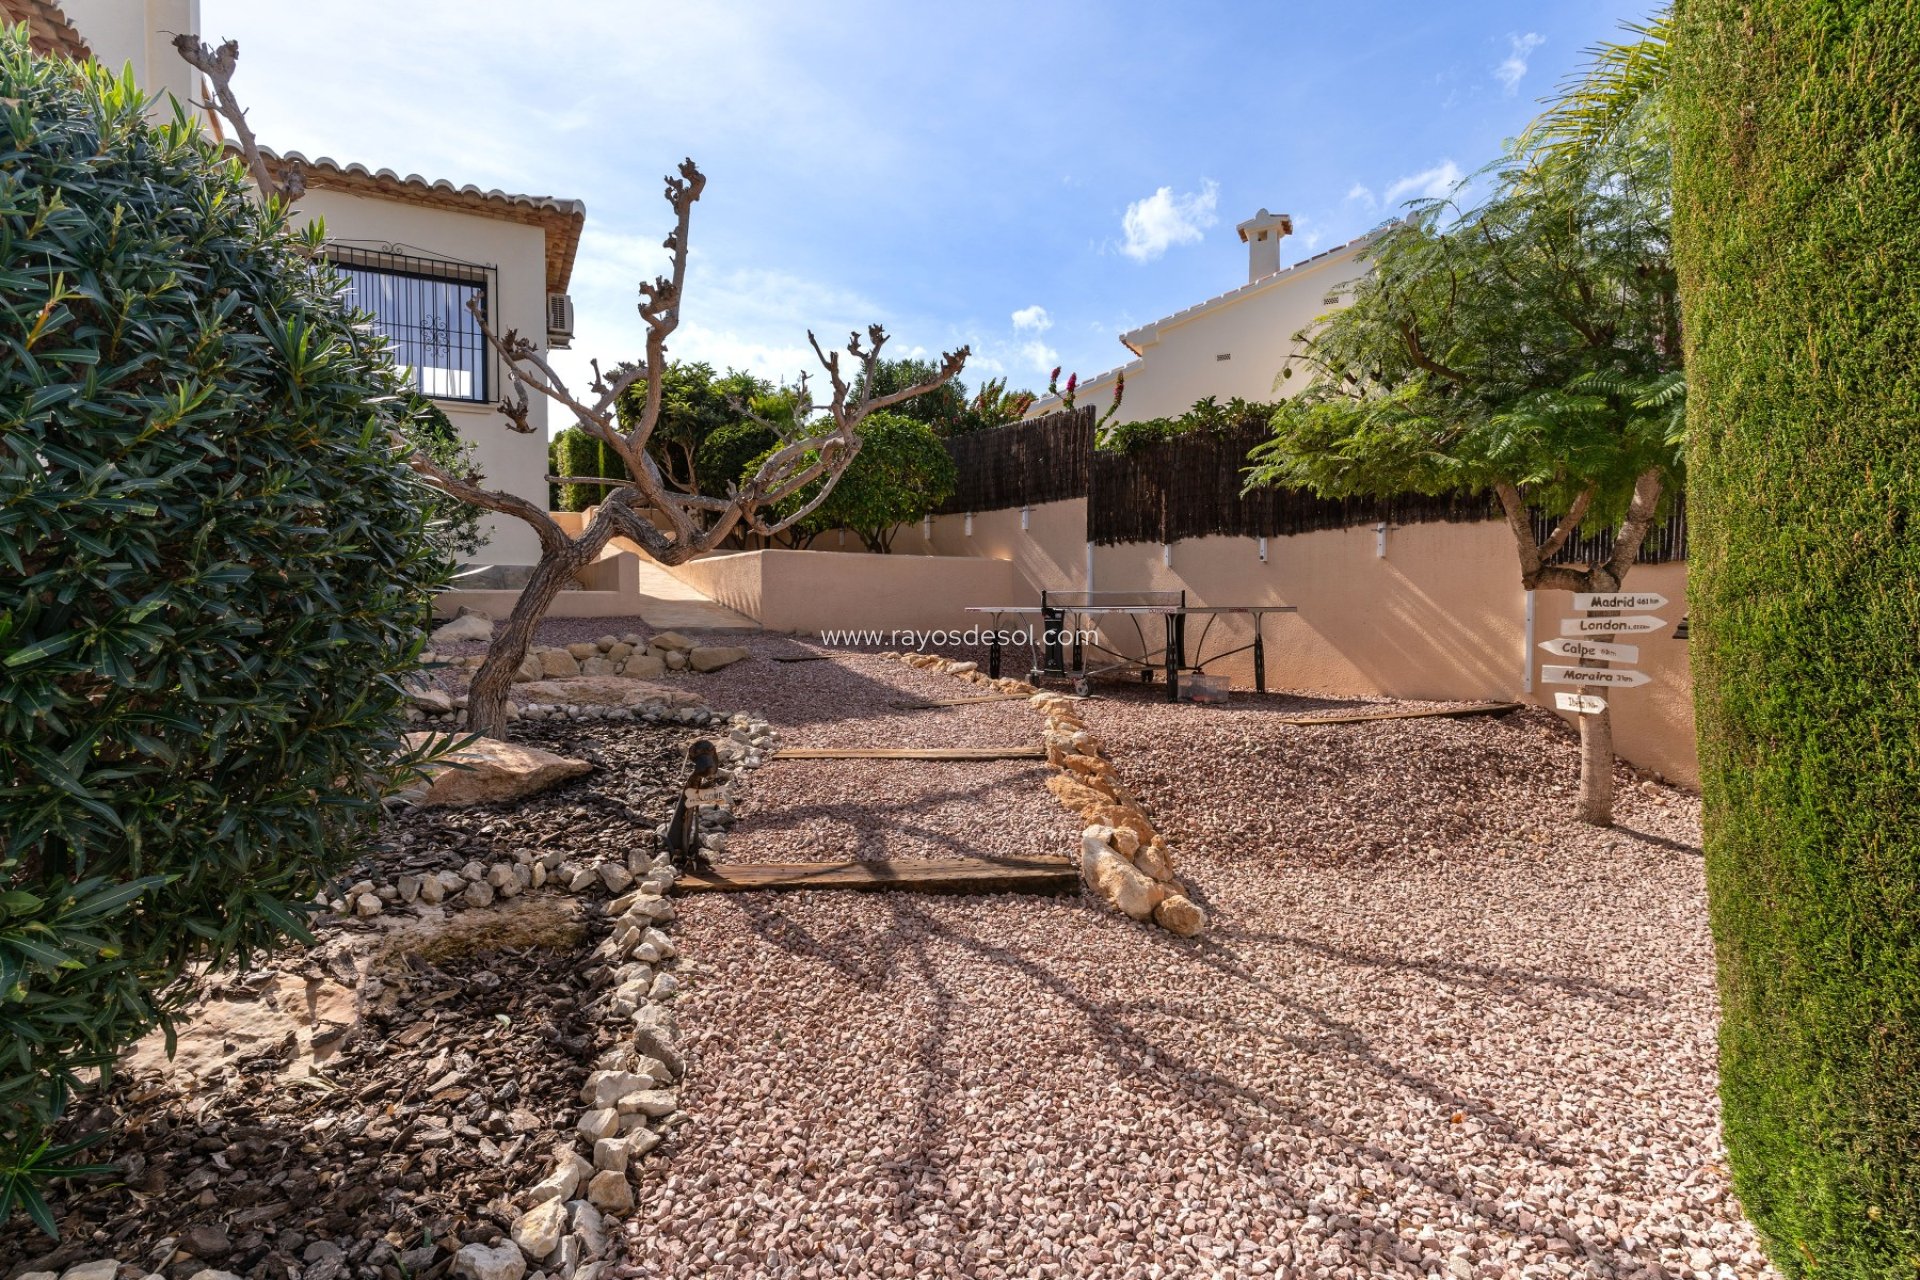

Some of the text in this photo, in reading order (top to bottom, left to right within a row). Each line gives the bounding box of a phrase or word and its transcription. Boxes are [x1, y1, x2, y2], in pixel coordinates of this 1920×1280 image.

[1590, 596, 1635, 608] Madrid
[1580, 619, 1627, 631] London
[1562, 642, 1596, 658] Calpe
[1563, 670, 1613, 681] Moraira
